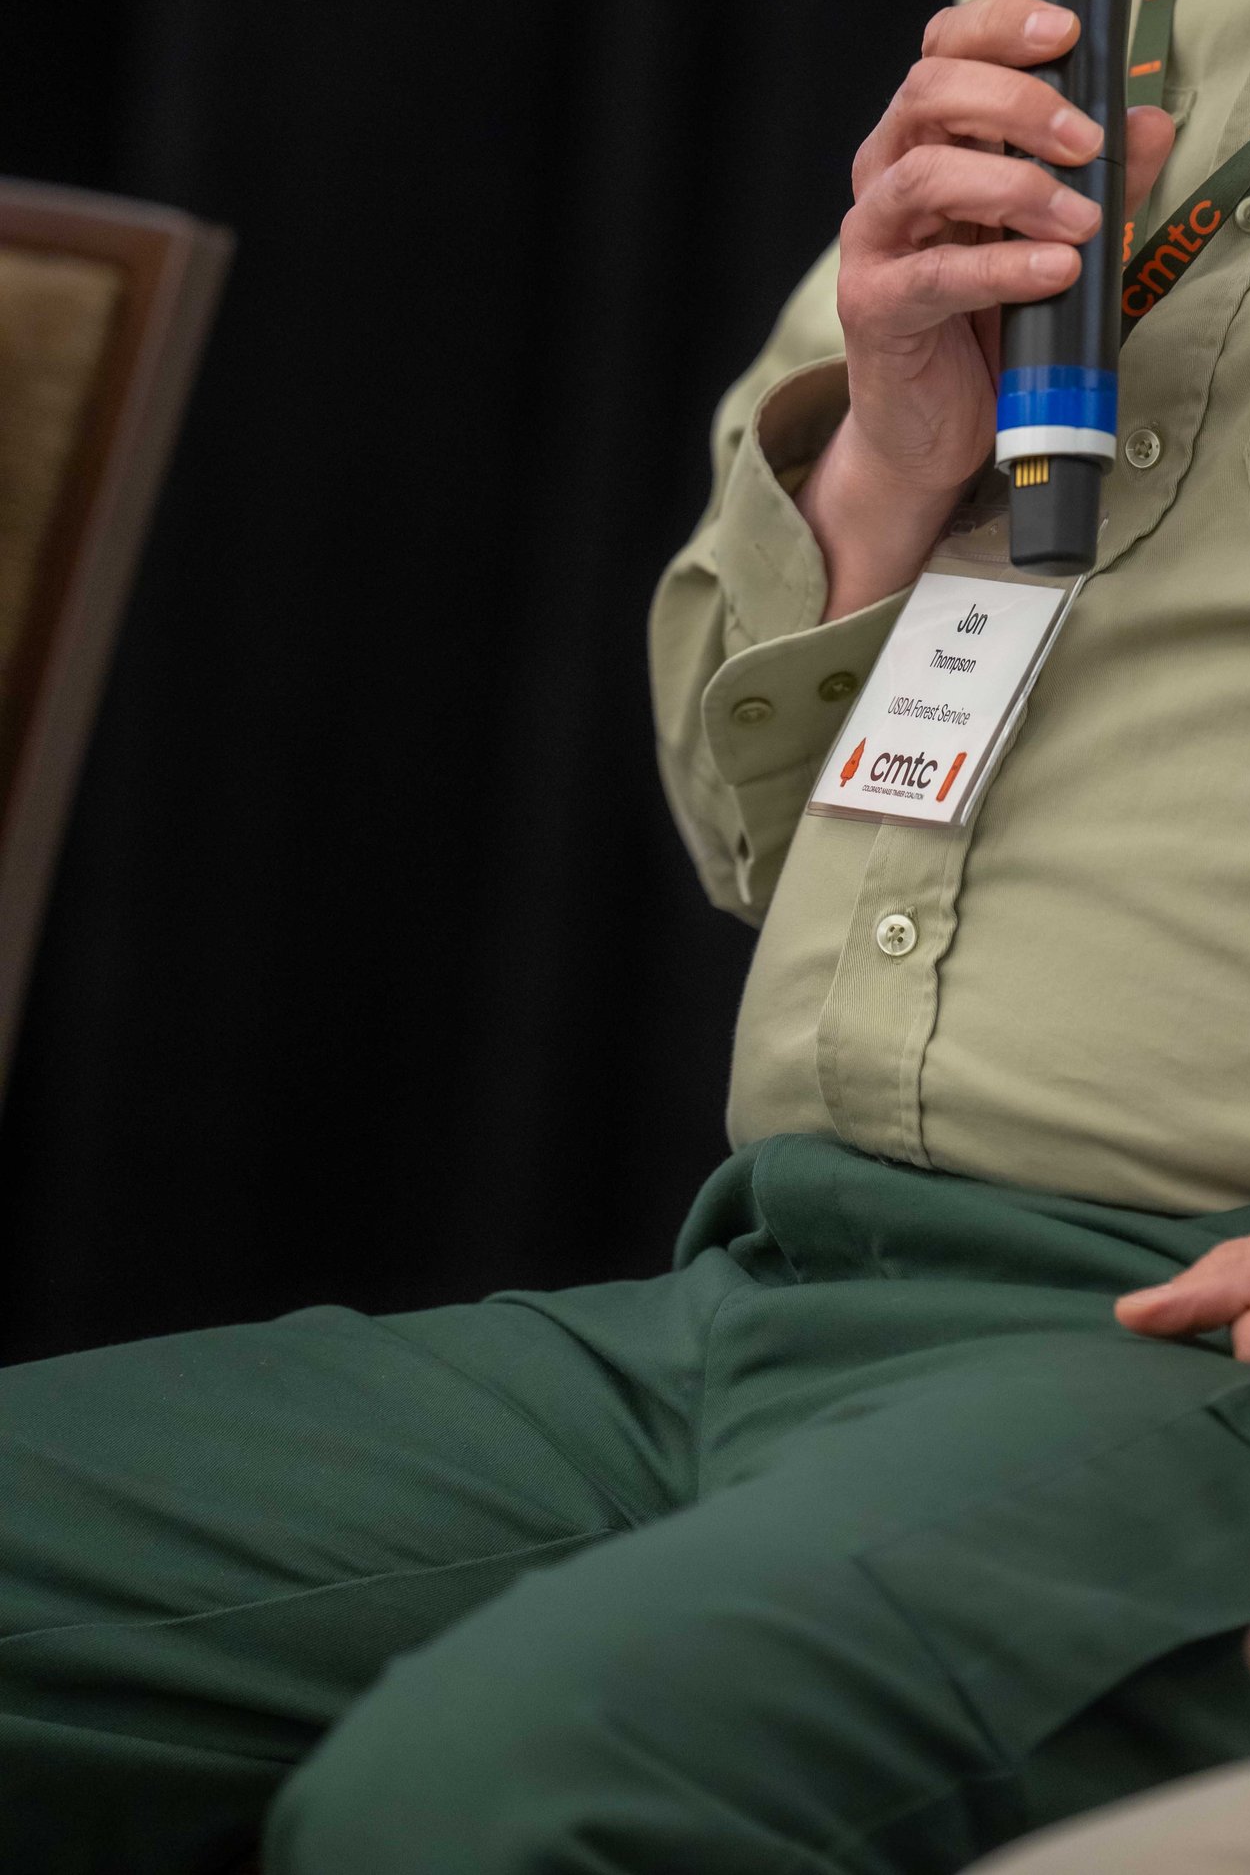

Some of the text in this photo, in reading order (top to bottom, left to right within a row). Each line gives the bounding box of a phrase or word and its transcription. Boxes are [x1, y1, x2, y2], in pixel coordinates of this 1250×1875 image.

[1122, 199, 1221, 317] cmtc
[957, 604, 988, 635] Jon
[929, 649, 976, 675] Thompson
[888, 696, 971, 726] USDA Forest Service
[870, 751, 938, 789] cmtc
